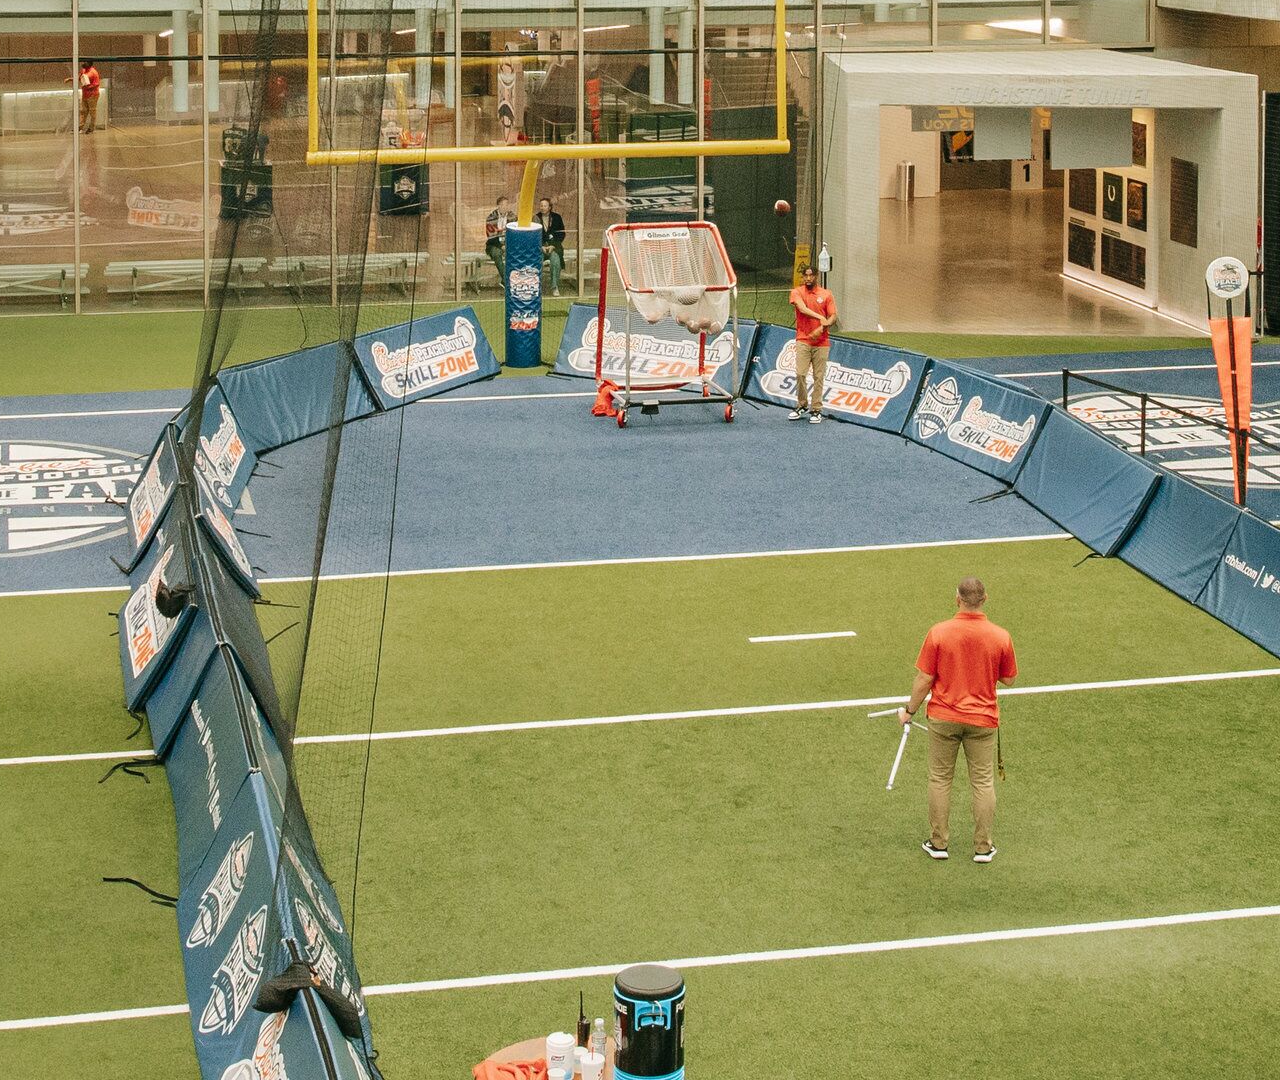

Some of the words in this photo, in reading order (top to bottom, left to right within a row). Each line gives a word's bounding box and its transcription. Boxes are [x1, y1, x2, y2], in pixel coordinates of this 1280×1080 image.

[1023, 163, 1030, 182] 1
[414, 340, 442, 362] PEACH
[441, 335, 470, 355] BOWL
[641, 339, 682, 359] PEACH
[826, 366, 862, 388] PEACH
[862, 373, 893, 394] BOWL
[1225, 554, 1258, 580] cfbhall.com
